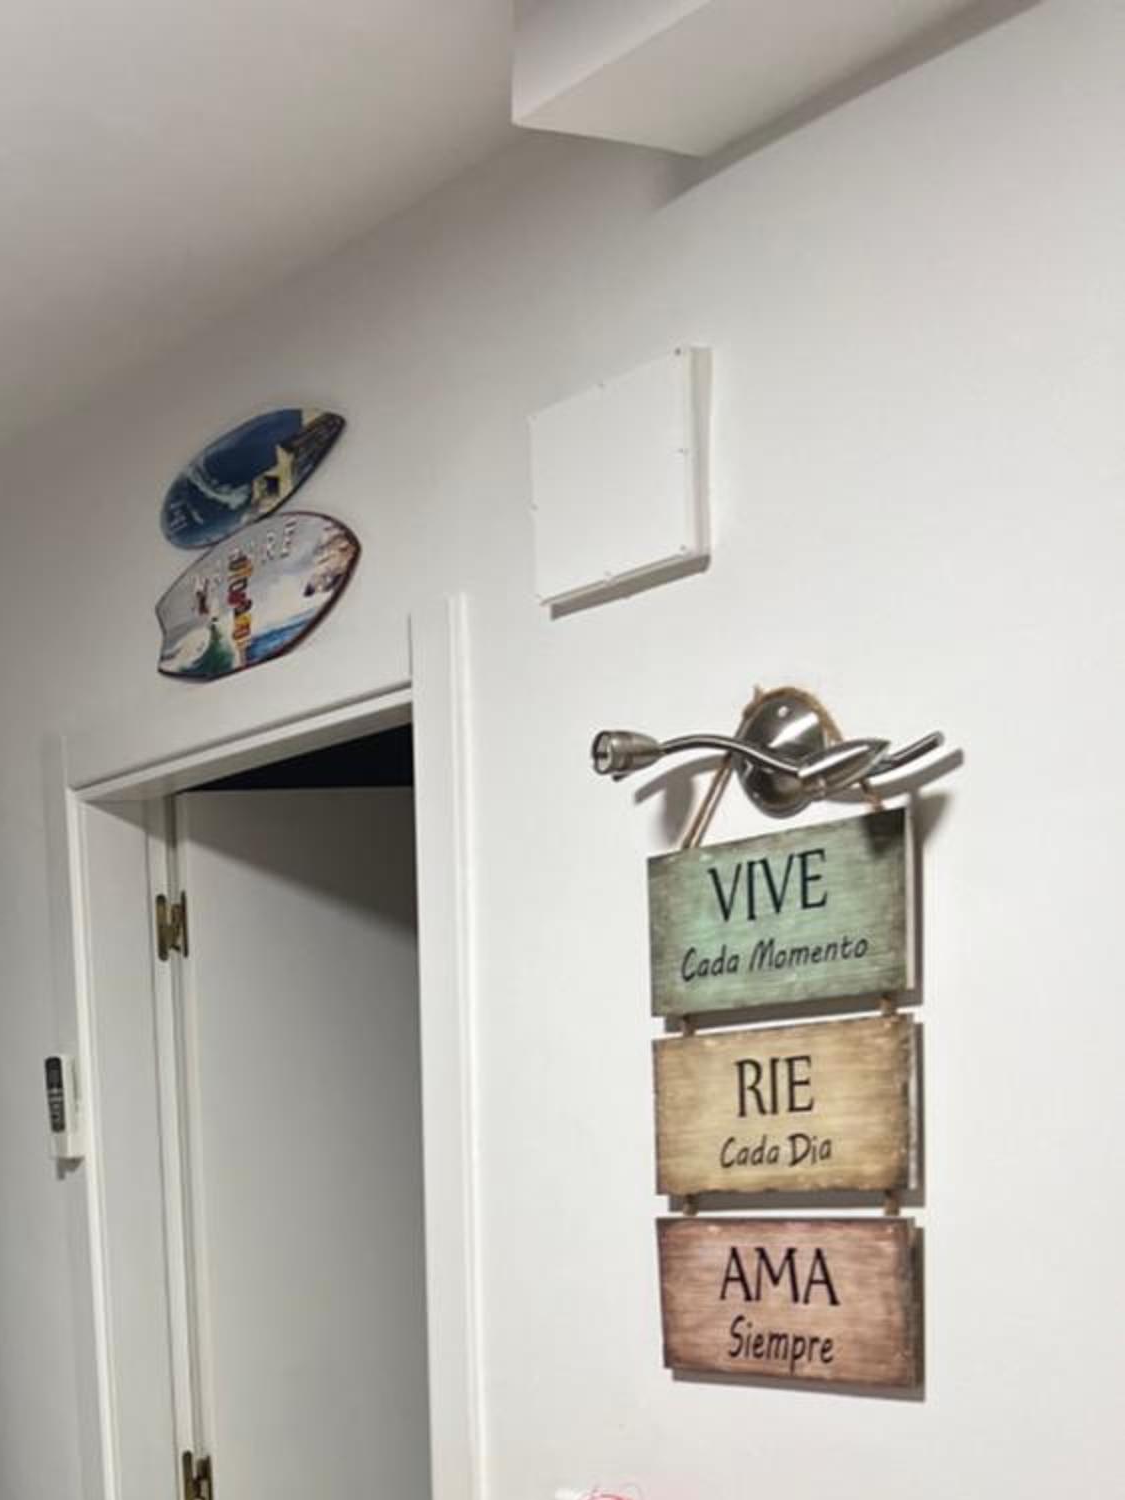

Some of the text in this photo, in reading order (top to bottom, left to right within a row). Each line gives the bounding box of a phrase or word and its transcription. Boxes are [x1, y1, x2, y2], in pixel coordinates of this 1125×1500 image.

[706, 847, 829, 924] VIVE
[680, 936, 871, 983] Cada Momento
[733, 1055, 815, 1119] RIE
[720, 1132, 833, 1169] Cada Dia
[718, 1245, 841, 1307] AMA
[728, 1313, 835, 1376] Siempre
